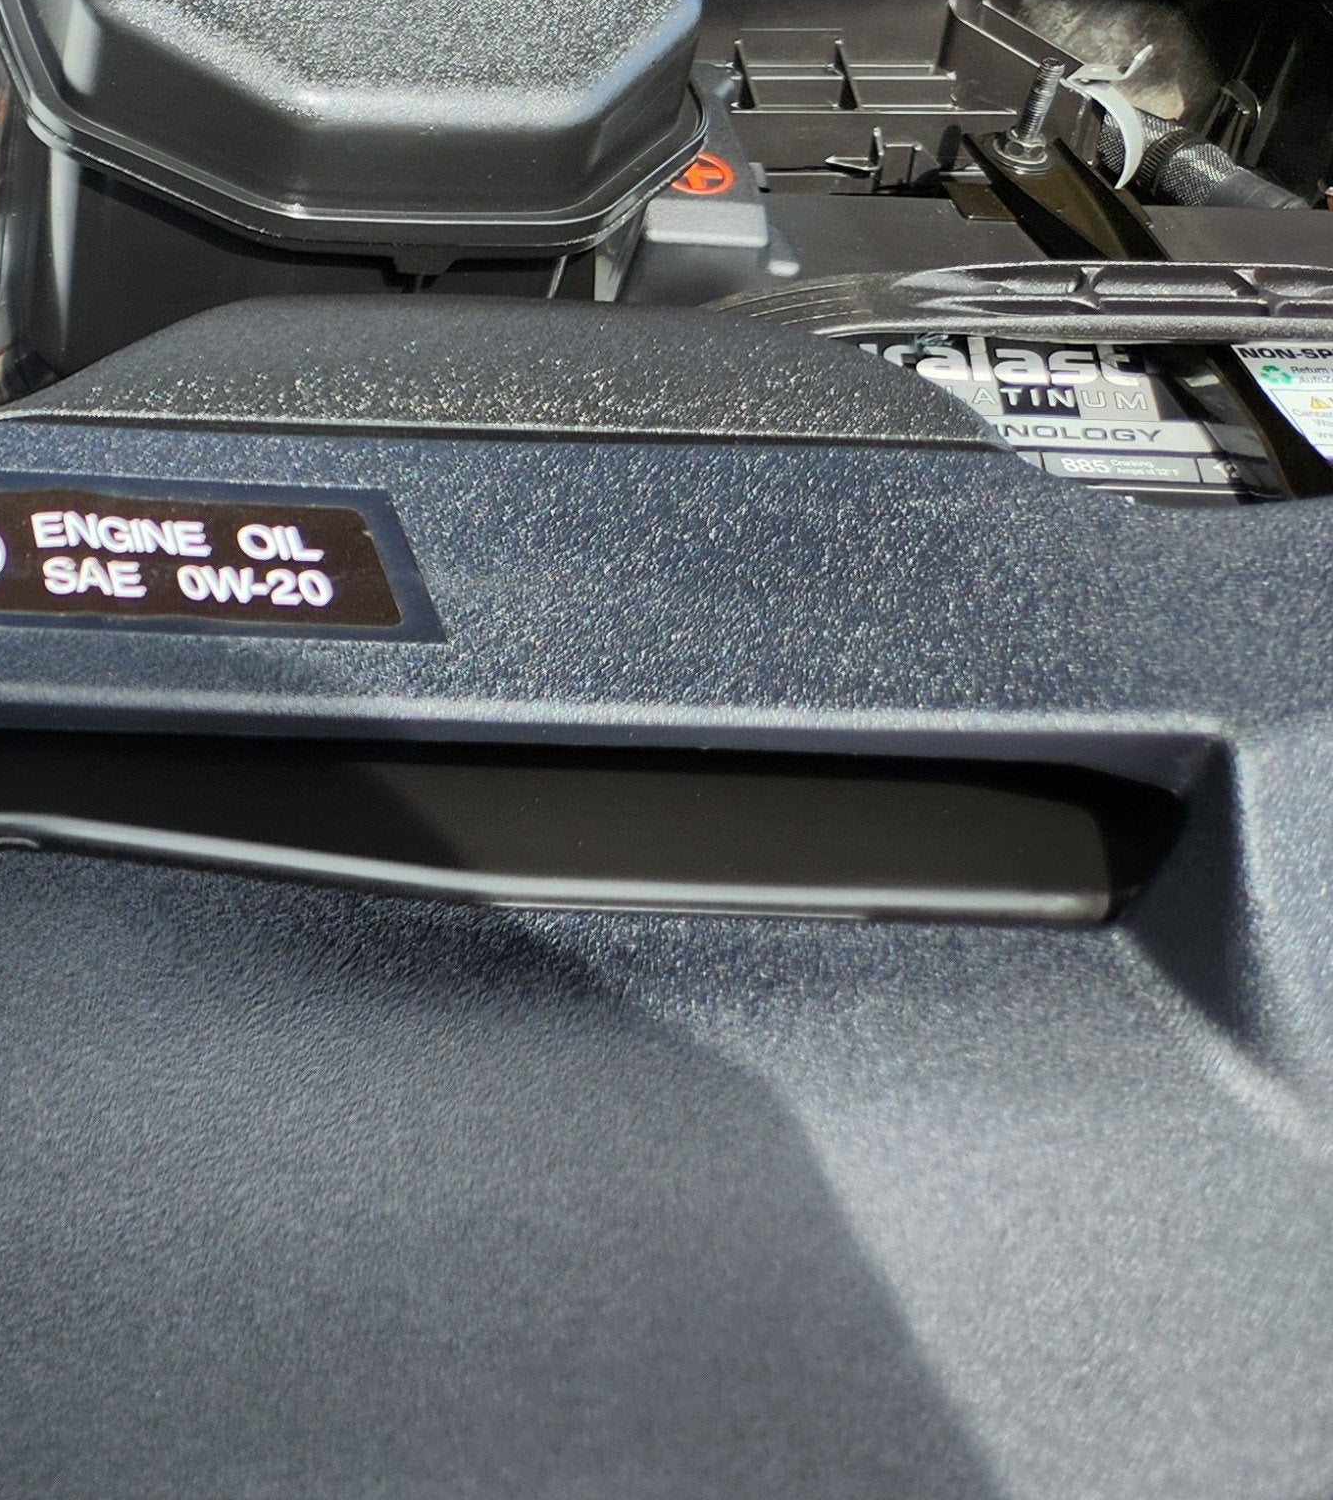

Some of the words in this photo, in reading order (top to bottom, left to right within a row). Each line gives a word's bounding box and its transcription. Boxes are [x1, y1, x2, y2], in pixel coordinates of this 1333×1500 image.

[1061, 458, 1111, 474] 885
[31, 510, 212, 557] ENGINE
[237, 523, 324, 561] OIL
[42, 556, 147, 598] SAE
[177, 564, 334, 607] 0W-20
